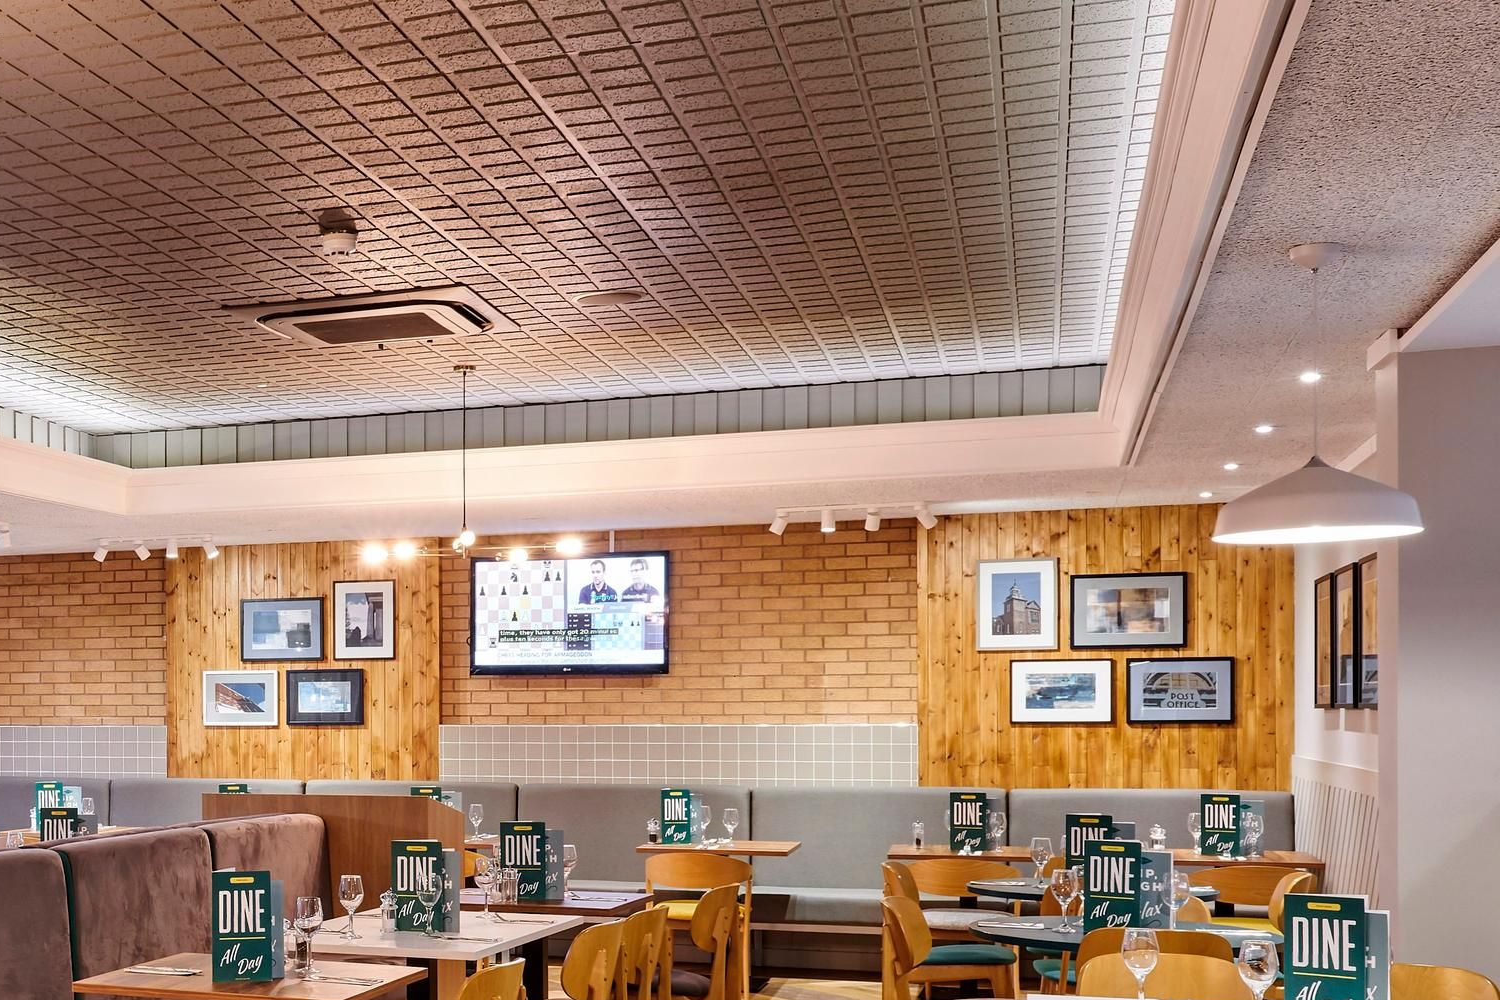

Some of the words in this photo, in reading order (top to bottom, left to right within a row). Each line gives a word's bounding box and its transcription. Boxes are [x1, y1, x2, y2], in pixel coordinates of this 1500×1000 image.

[38, 790, 60, 809] DINE
[664, 798, 688, 820] DINE
[954, 802, 983, 826] DINE
[1204, 804, 1237, 829] DINE
[44, 819, 74, 842] DINE
[1205, 833, 1220, 847] All
[505, 835, 541, 866] DINE
[1217, 841, 1235, 852] Day
[397, 856, 437, 891] DINE
[1089, 855, 1136, 894] DINE
[520, 881, 539, 895] Day
[218, 889, 266, 933] DINE
[398, 900, 415, 918] All
[1090, 901, 1110, 919] All
[1107, 913, 1132, 928] Day
[220, 943, 241, 967] All
[1292, 916, 1357, 972] DINE
[237, 955, 264, 975] Day
